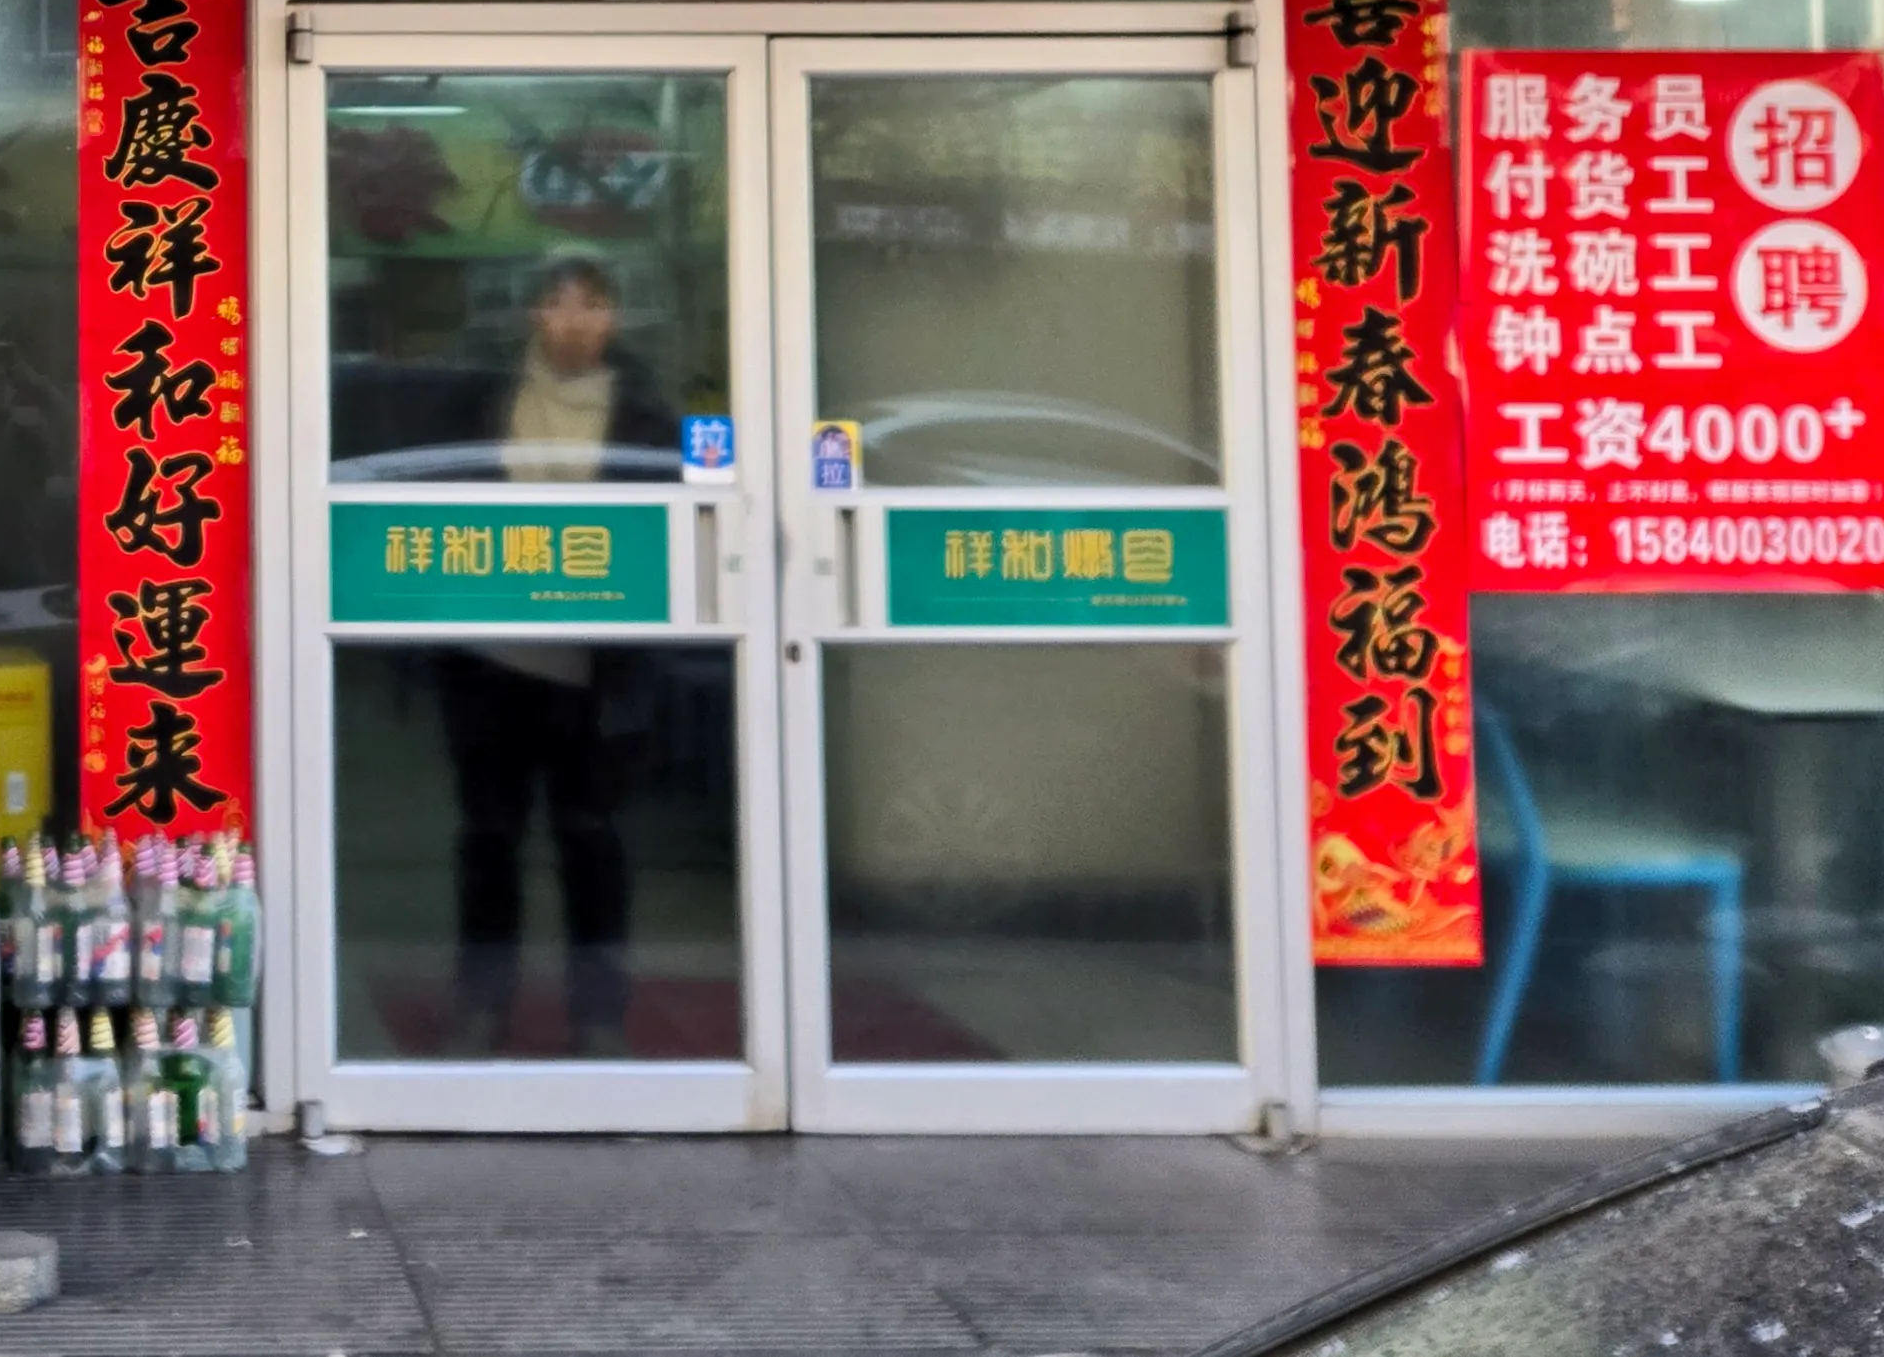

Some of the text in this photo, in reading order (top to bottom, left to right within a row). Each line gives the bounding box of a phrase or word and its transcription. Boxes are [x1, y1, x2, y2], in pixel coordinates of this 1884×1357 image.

[1482, 72, 1713, 143] 服务员
[1483, 151, 1715, 221] 付货工
[1486, 228, 1718, 297] 洗碗工
[1489, 305, 1724, 376] 钟点工
